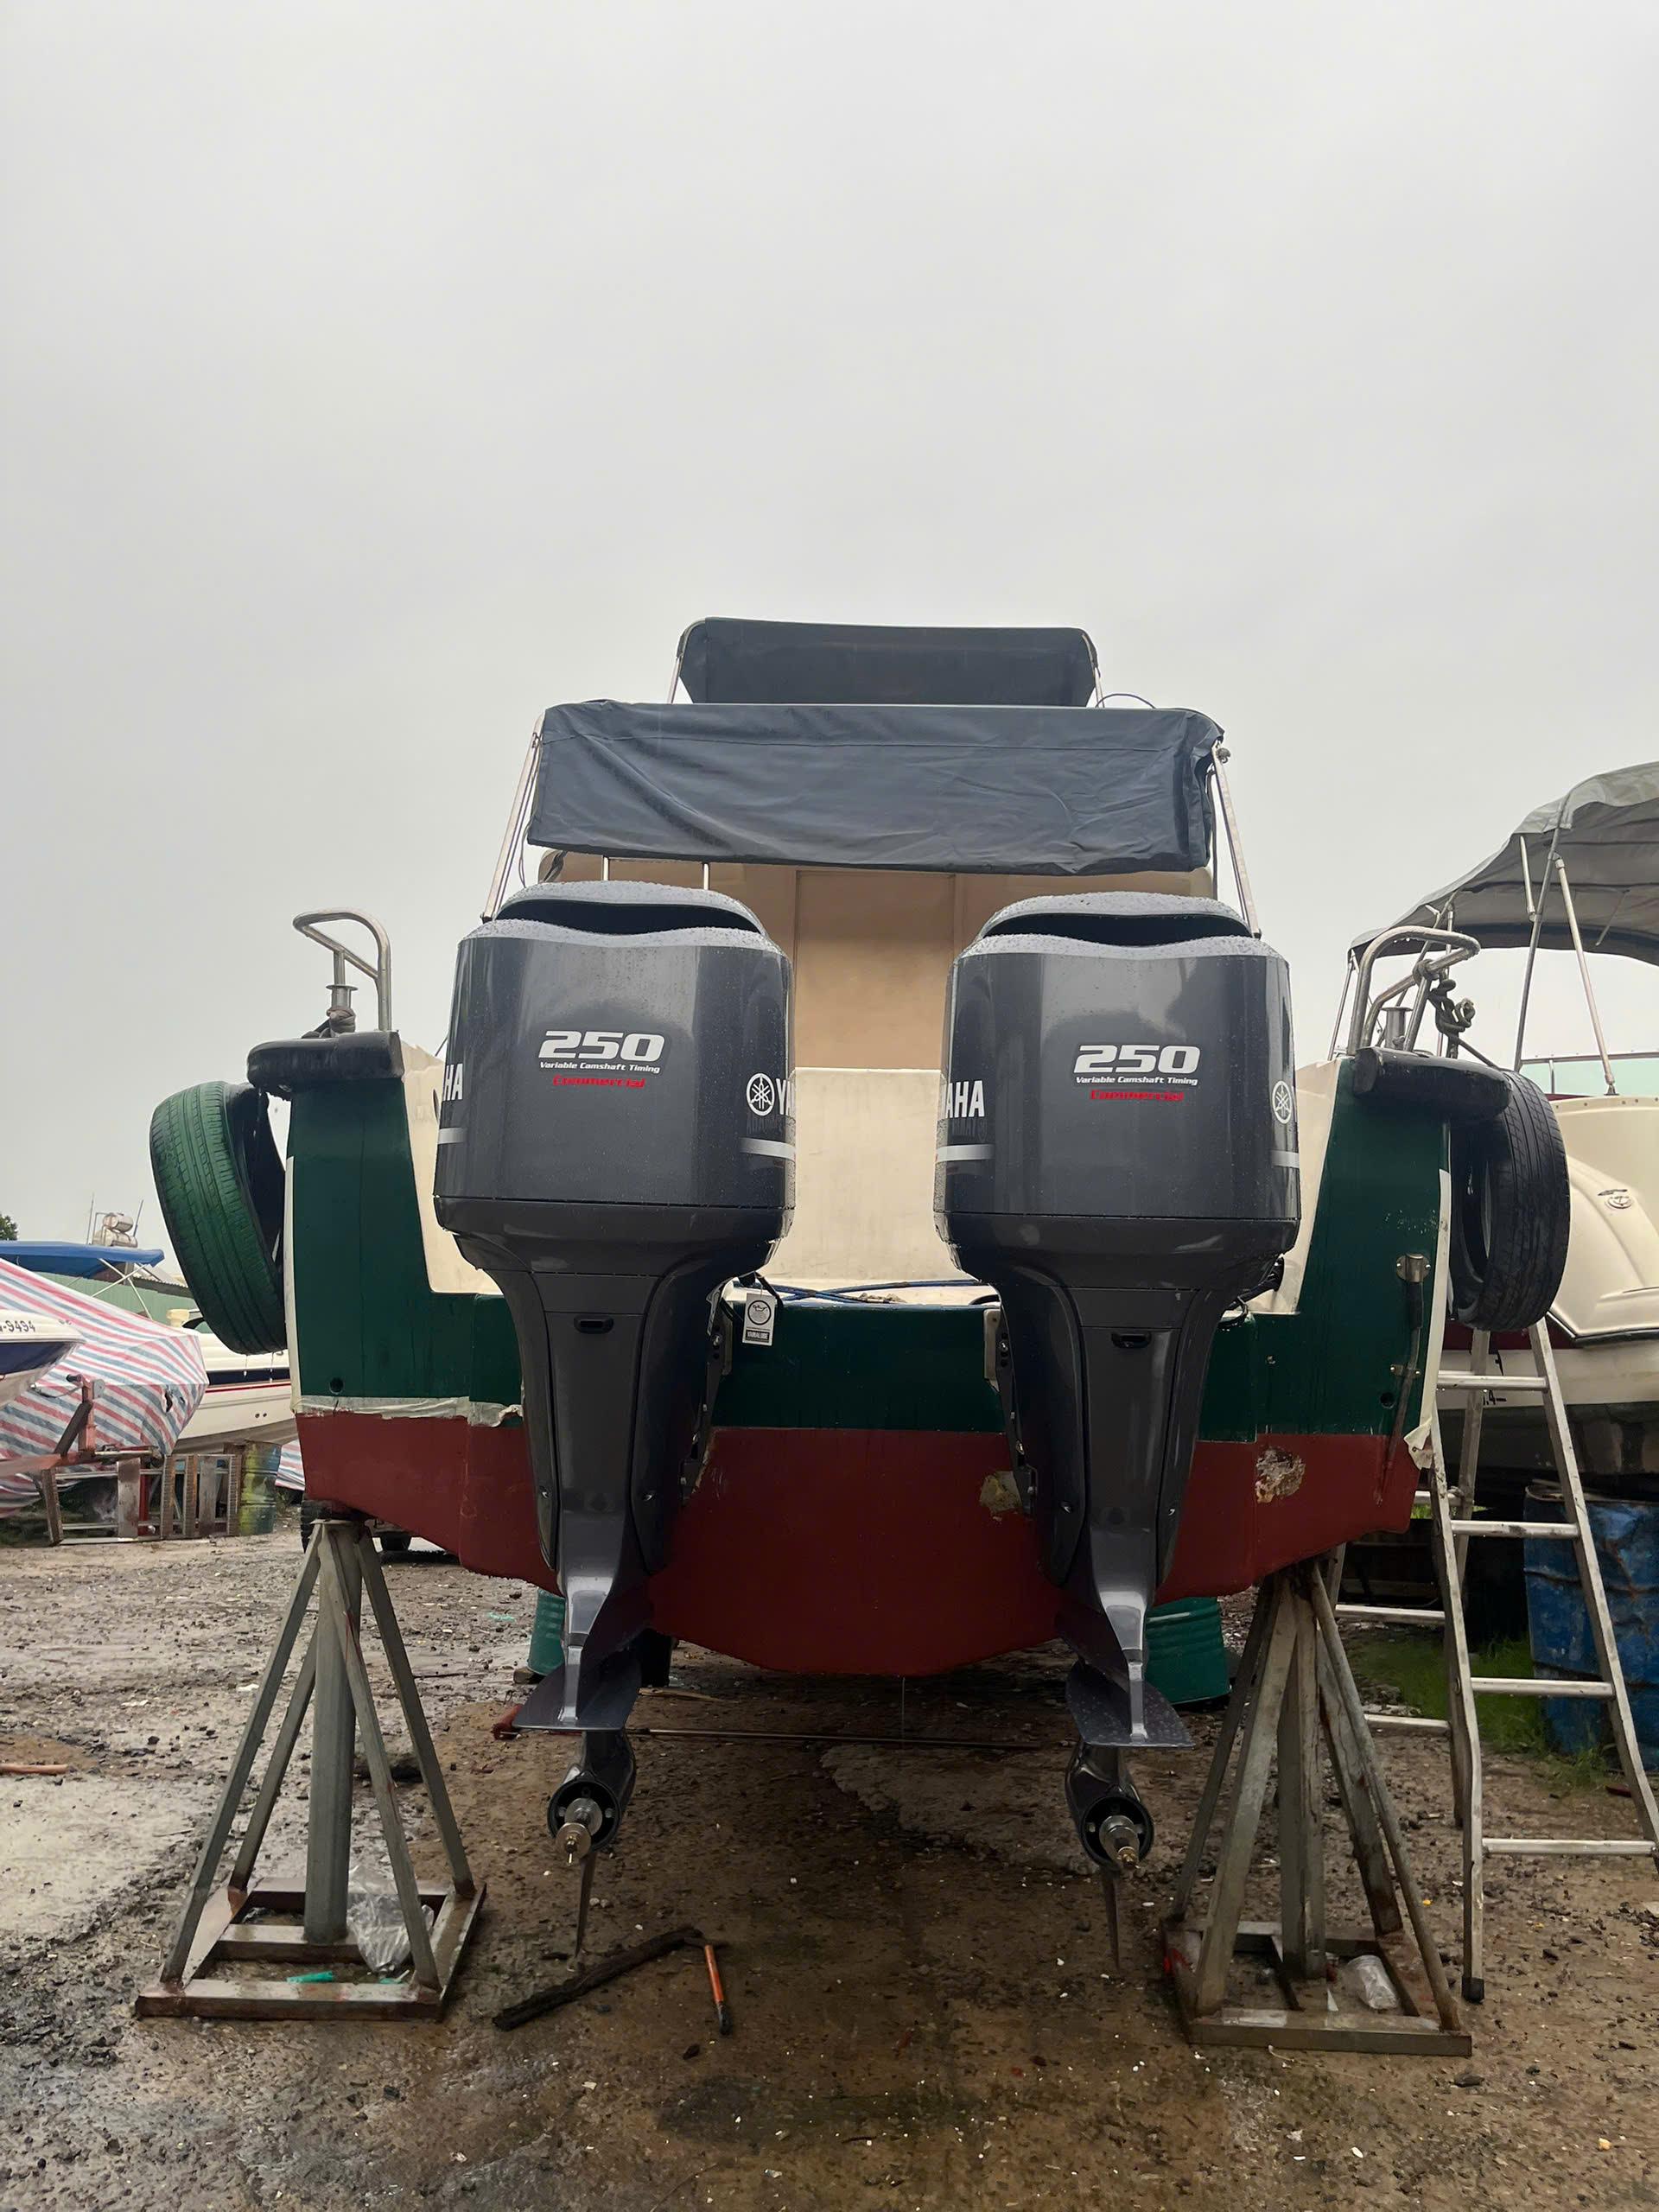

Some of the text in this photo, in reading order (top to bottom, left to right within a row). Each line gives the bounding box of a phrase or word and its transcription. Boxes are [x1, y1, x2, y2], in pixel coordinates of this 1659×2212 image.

[538, 1030, 665, 1062] 250
[540, 1061, 661, 1074] Variable Camshaft Timing
[1073, 1045, 1201, 1074] 250
[1076, 1076, 1198, 1086] Variable Camshaft Timing
